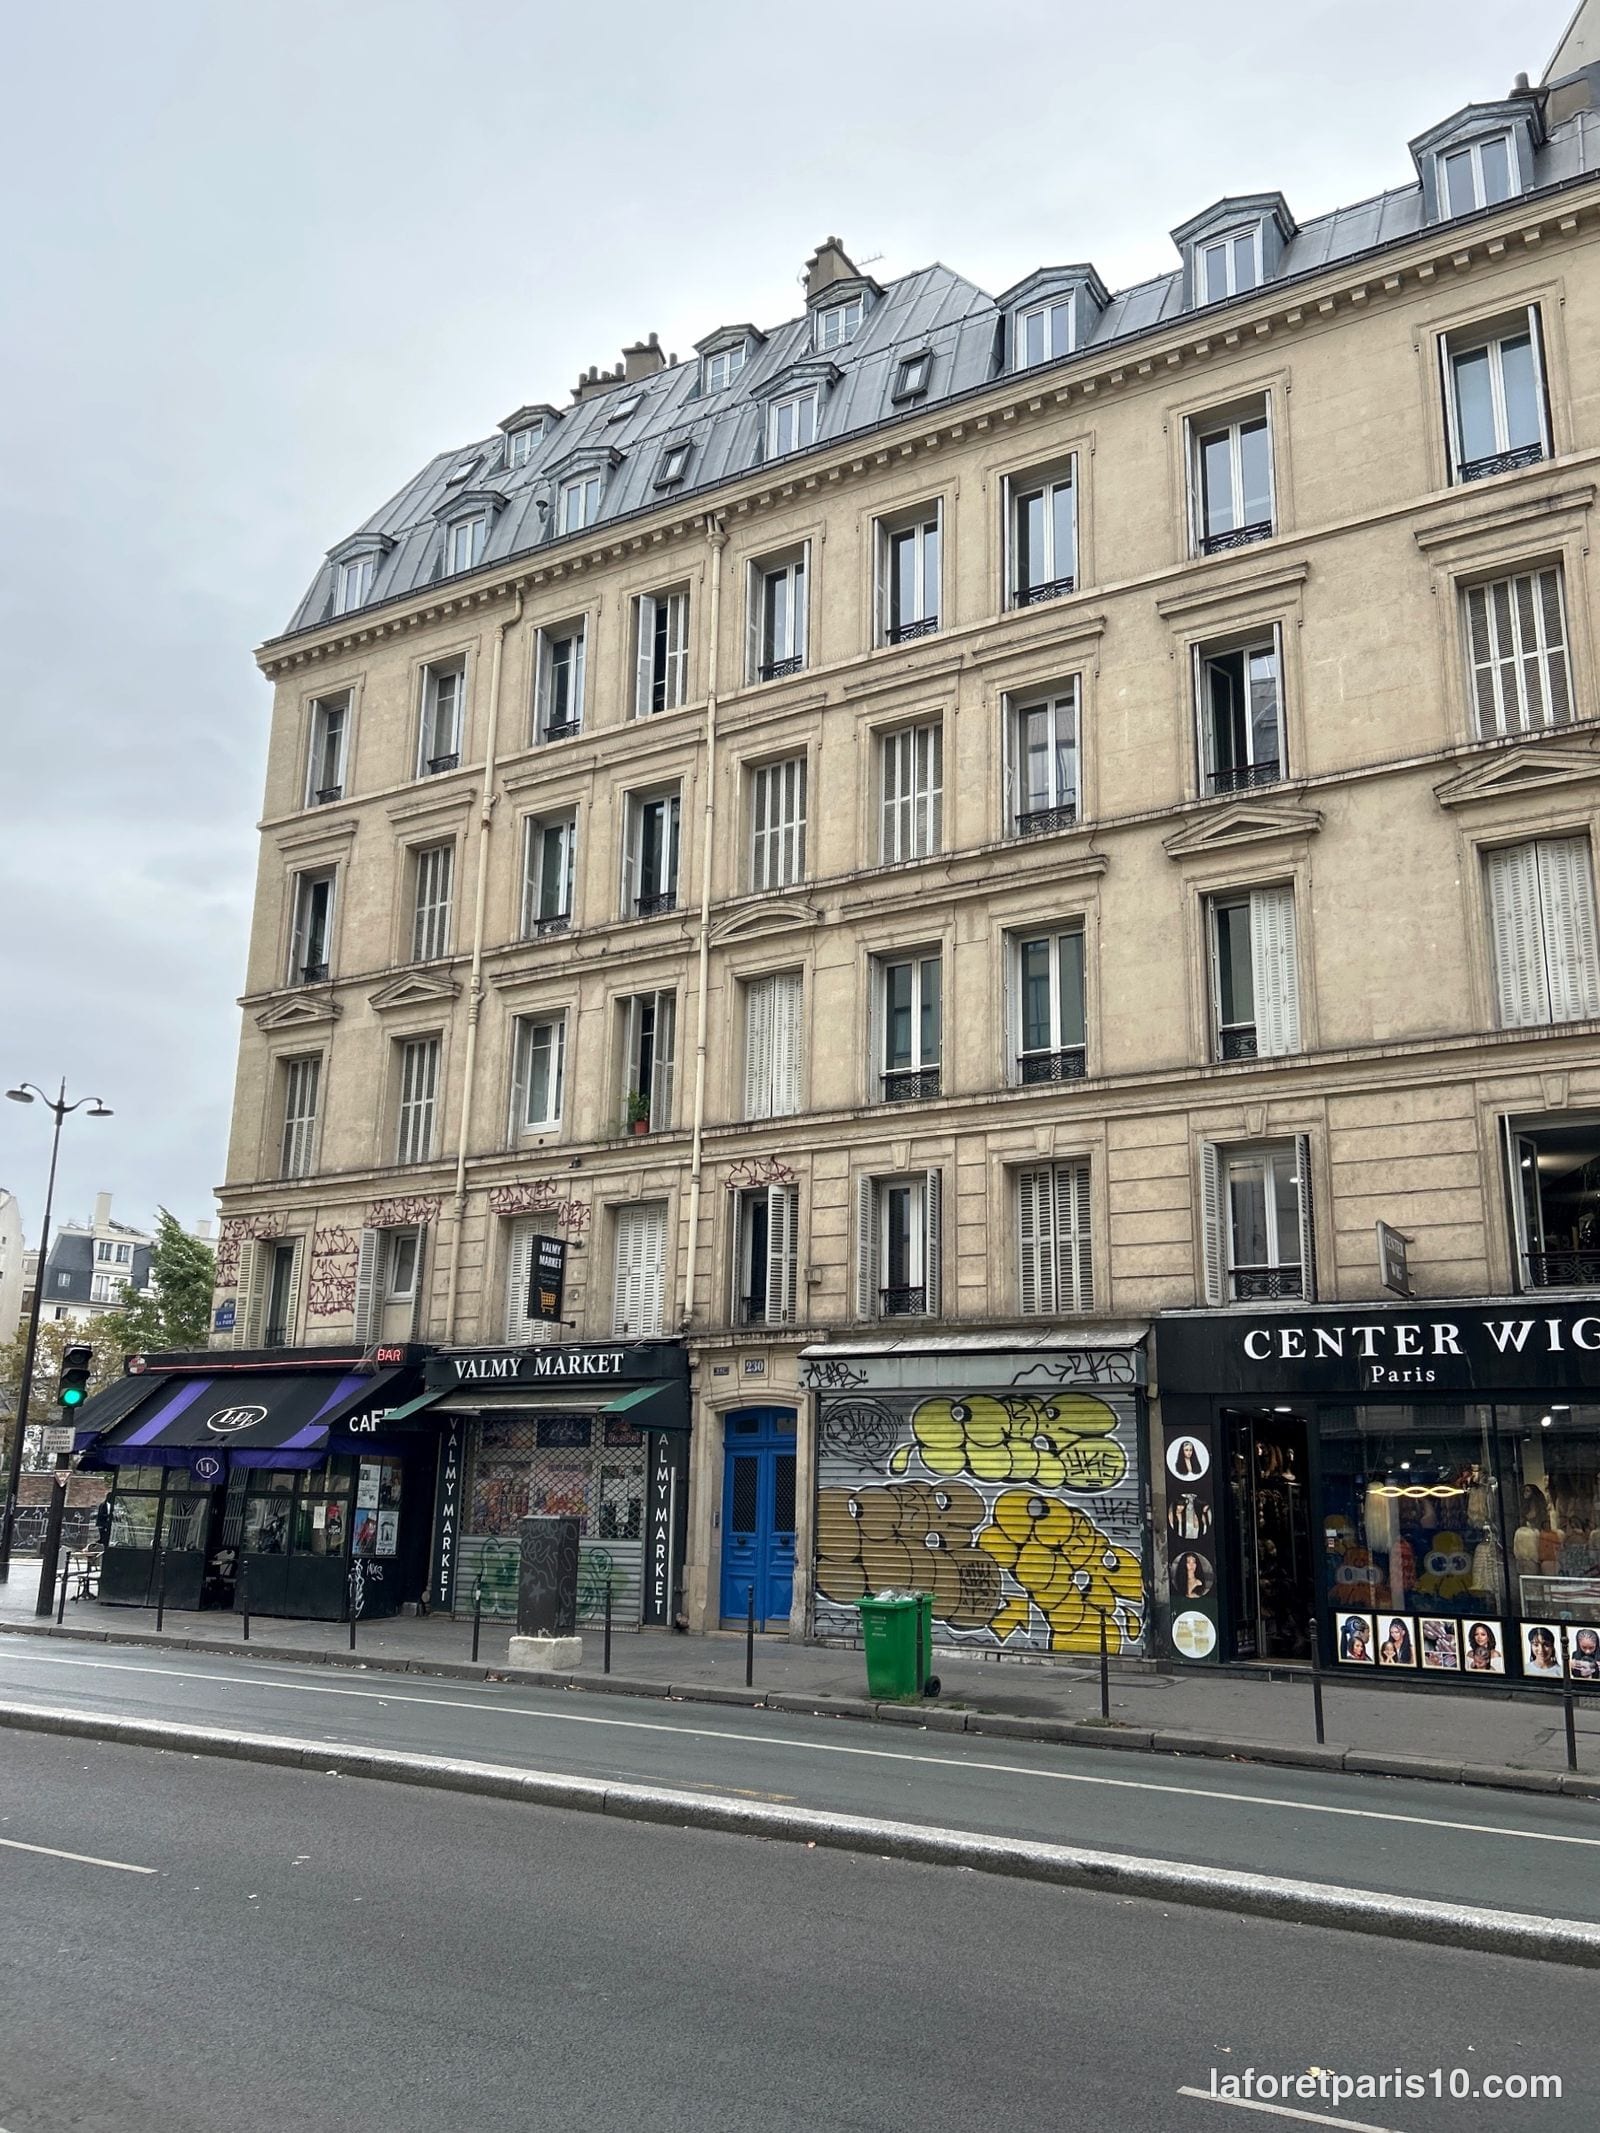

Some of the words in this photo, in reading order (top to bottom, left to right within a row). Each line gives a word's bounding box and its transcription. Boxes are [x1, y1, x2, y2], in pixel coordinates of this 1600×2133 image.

[538, 1254, 562, 1269] MARKET
[541, 1241, 562, 1256] VALMY
[1243, 1323, 1464, 1360] CENTER
[1482, 1317, 1600, 1353] WIG
[377, 1348, 401, 1362] BAR
[454, 1357, 522, 1379] VALMY
[533, 1352, 624, 1376] MARKET
[745, 1360, 764, 1373] 230
[1371, 1365, 1436, 1383] Paris
[445, 1418, 458, 1496] VALMY
[656, 1433, 669, 1499] ALMY
[440, 1503, 454, 1601] MARKET
[654, 1507, 668, 1615] MARKET
